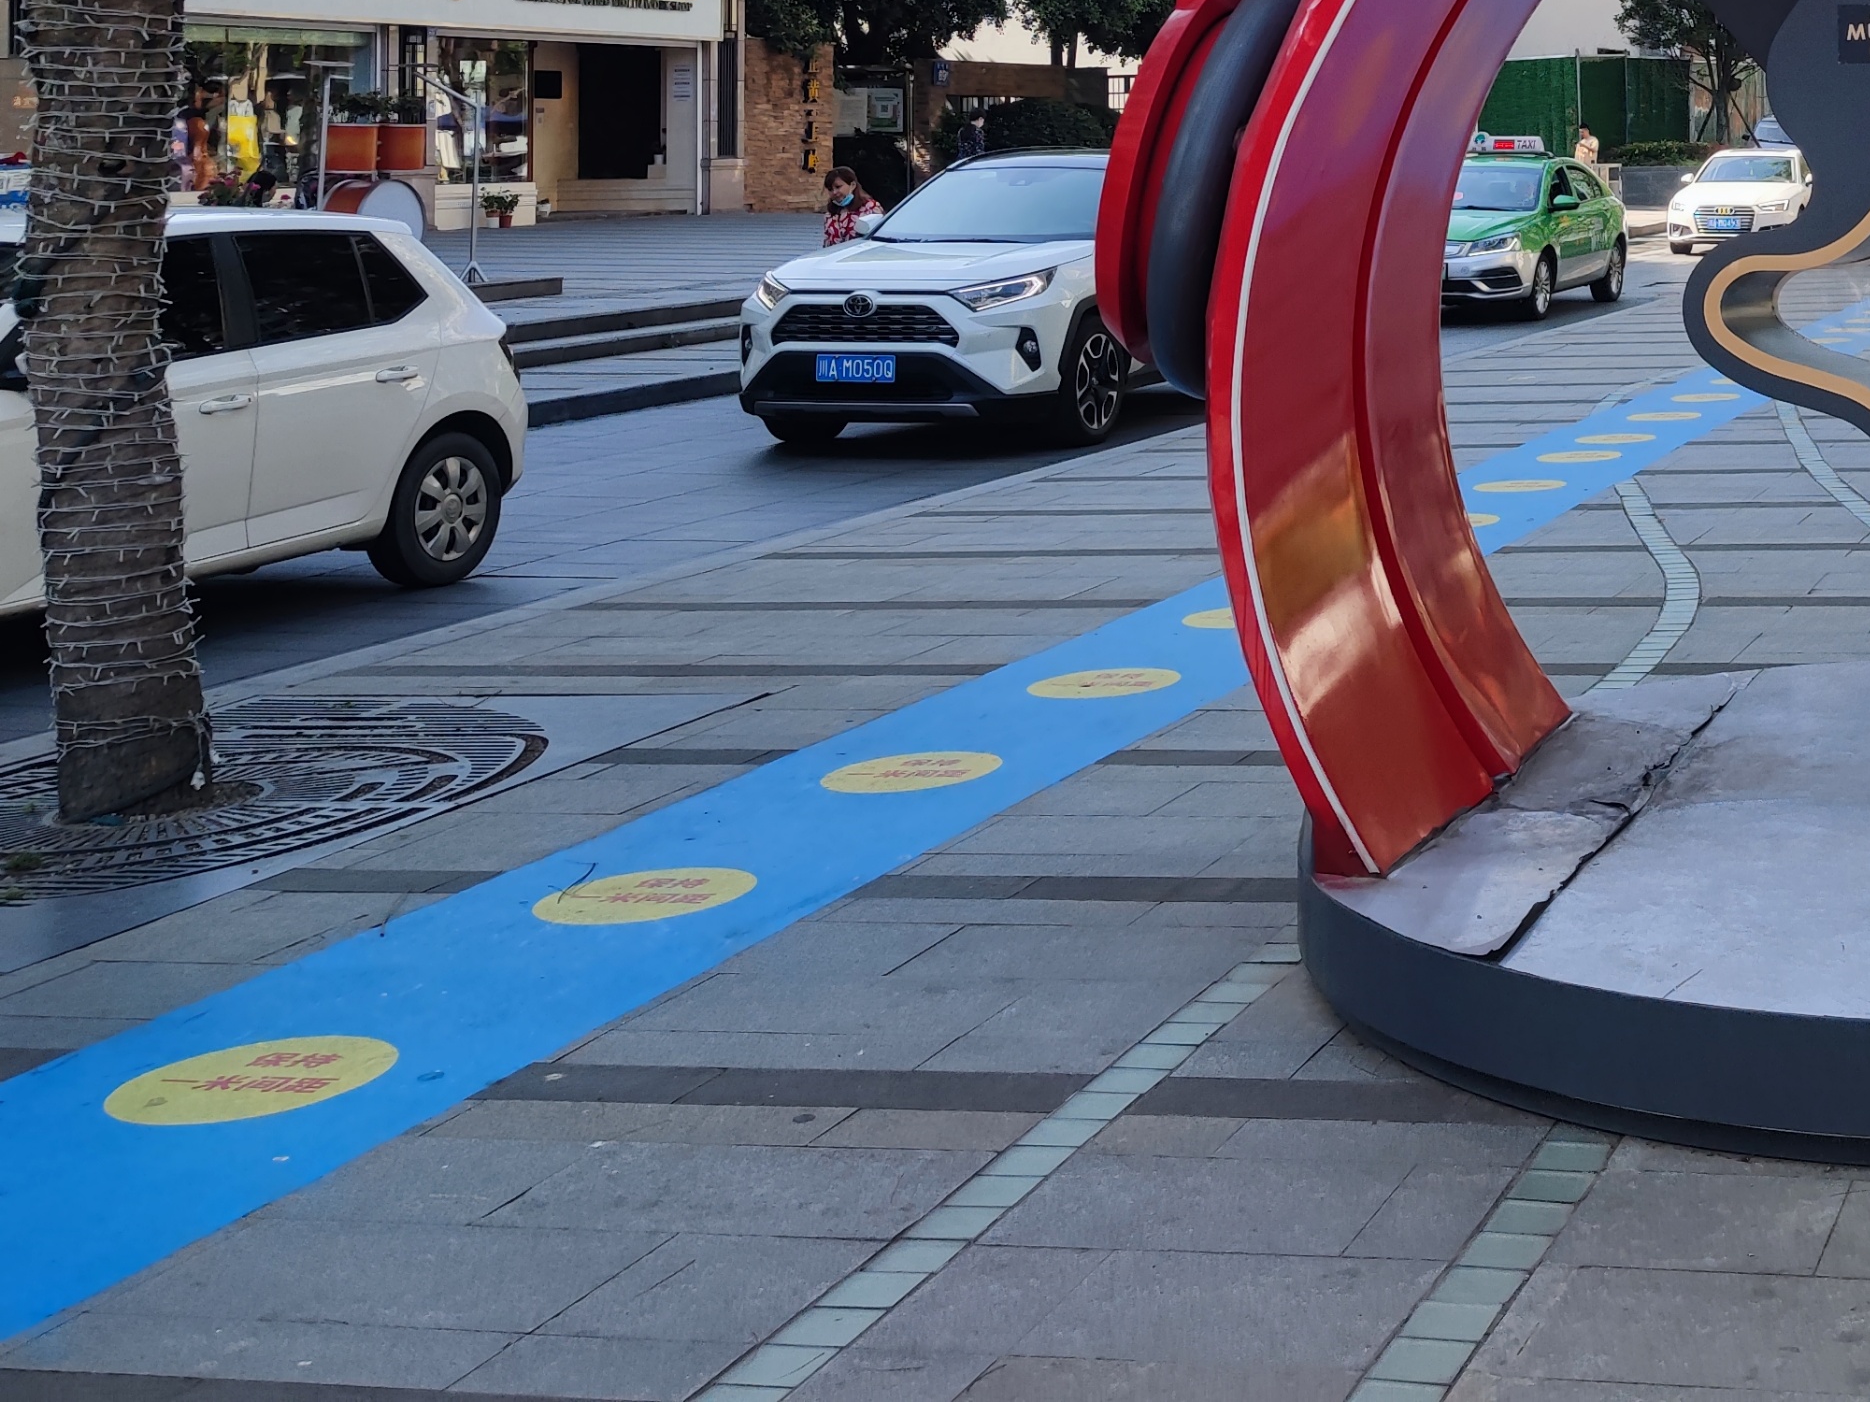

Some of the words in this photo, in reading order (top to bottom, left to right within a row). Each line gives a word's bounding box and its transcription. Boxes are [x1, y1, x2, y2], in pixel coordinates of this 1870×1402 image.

[1517, 140, 1536, 150] TAXI
[246, 1052, 344, 1068] 保持
[160, 1075, 340, 1094] 一米间距
